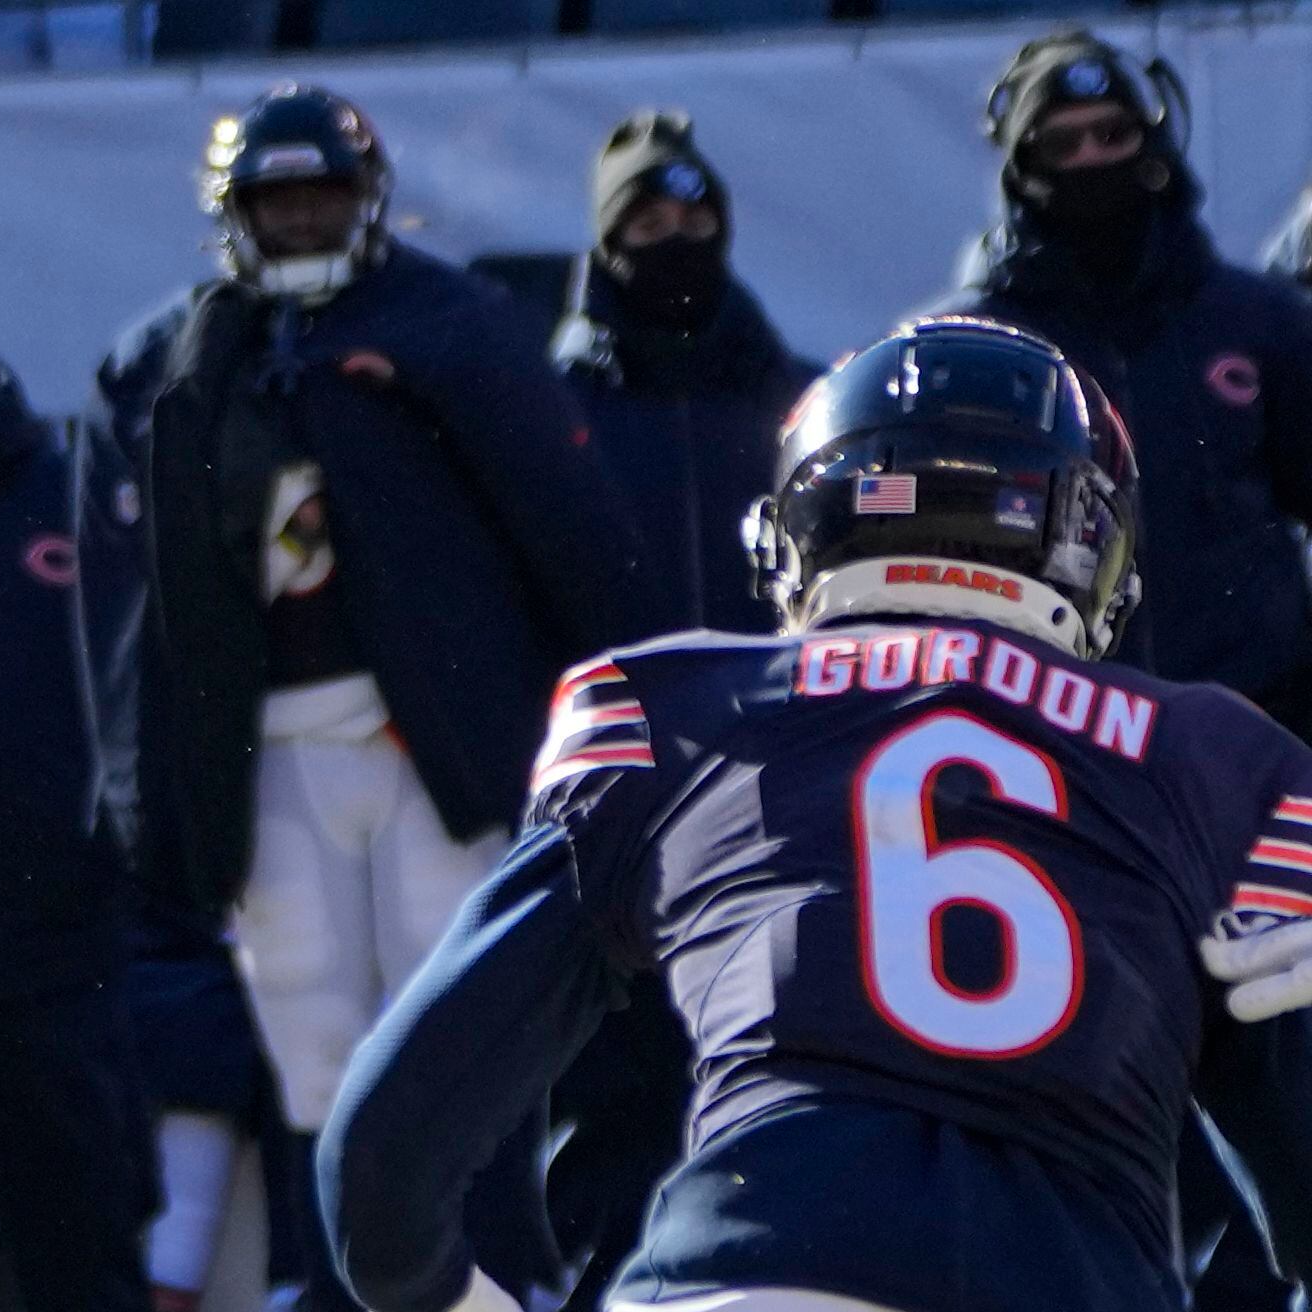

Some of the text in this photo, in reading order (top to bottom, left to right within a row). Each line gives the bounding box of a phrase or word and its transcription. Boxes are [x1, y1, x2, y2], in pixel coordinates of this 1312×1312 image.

[886, 564, 1022, 602] BEARS
[797, 628, 1158, 763] GORDON
[853, 707, 1085, 1061] 6
